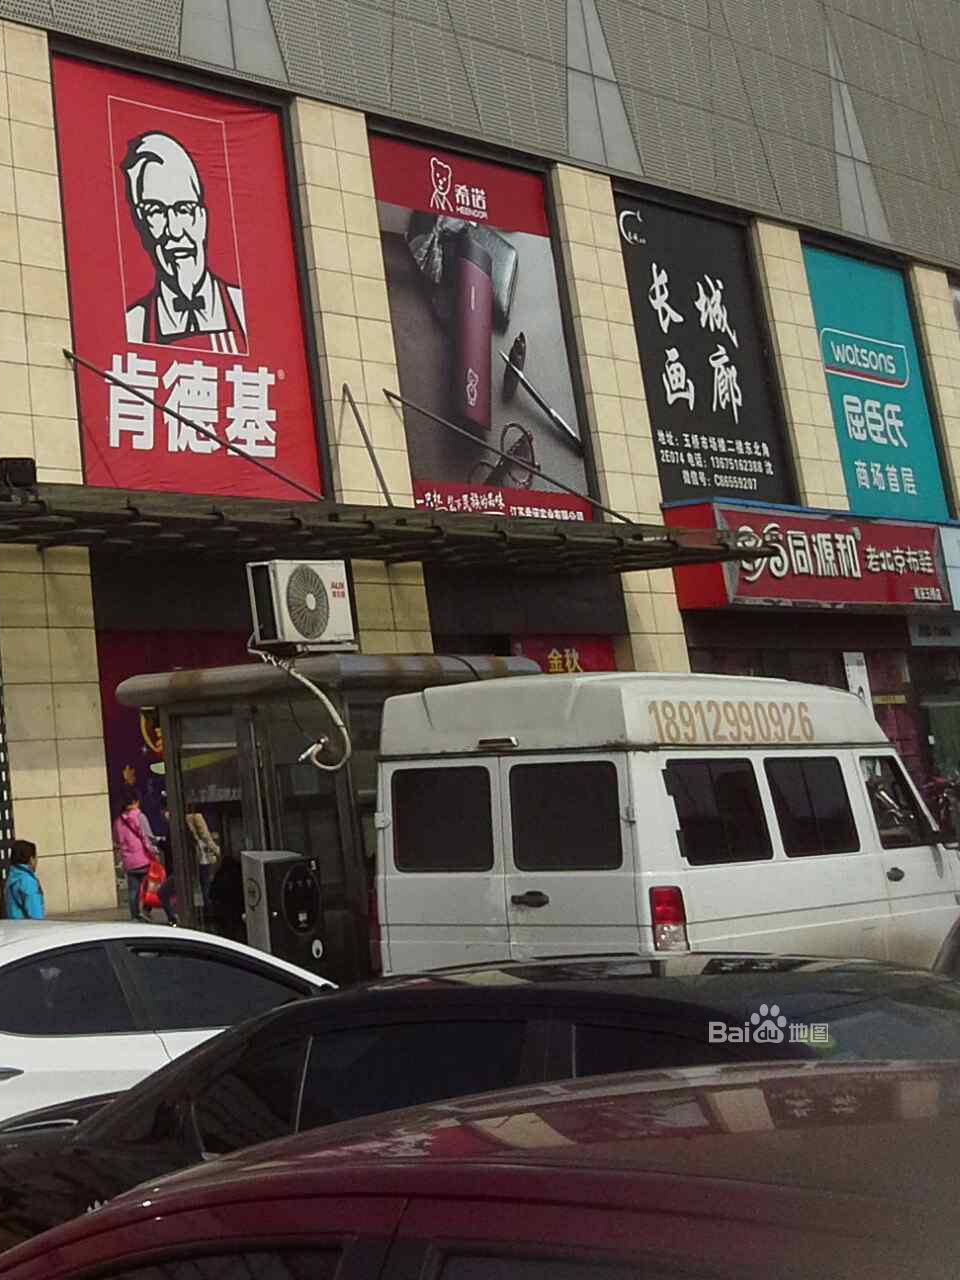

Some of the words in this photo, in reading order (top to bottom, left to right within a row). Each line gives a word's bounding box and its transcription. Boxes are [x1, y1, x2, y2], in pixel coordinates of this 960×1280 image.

[455, 184, 487, 210] 希诺
[648, 262, 738, 348] 长城
[830, 340, 897, 375] watsons
[104, 352, 277, 459] 肯德基
[662, 344, 742, 424] 画廊
[843, 395, 908, 449] 屈臣氏
[854, 459, 918, 497] 商场首层
[786, 530, 862, 579] 同源和
[864, 544, 935, 576] 老北京布鞋
[547, 647, 584, 673] 金秋
[648, 699, 815, 743] 18912990926
